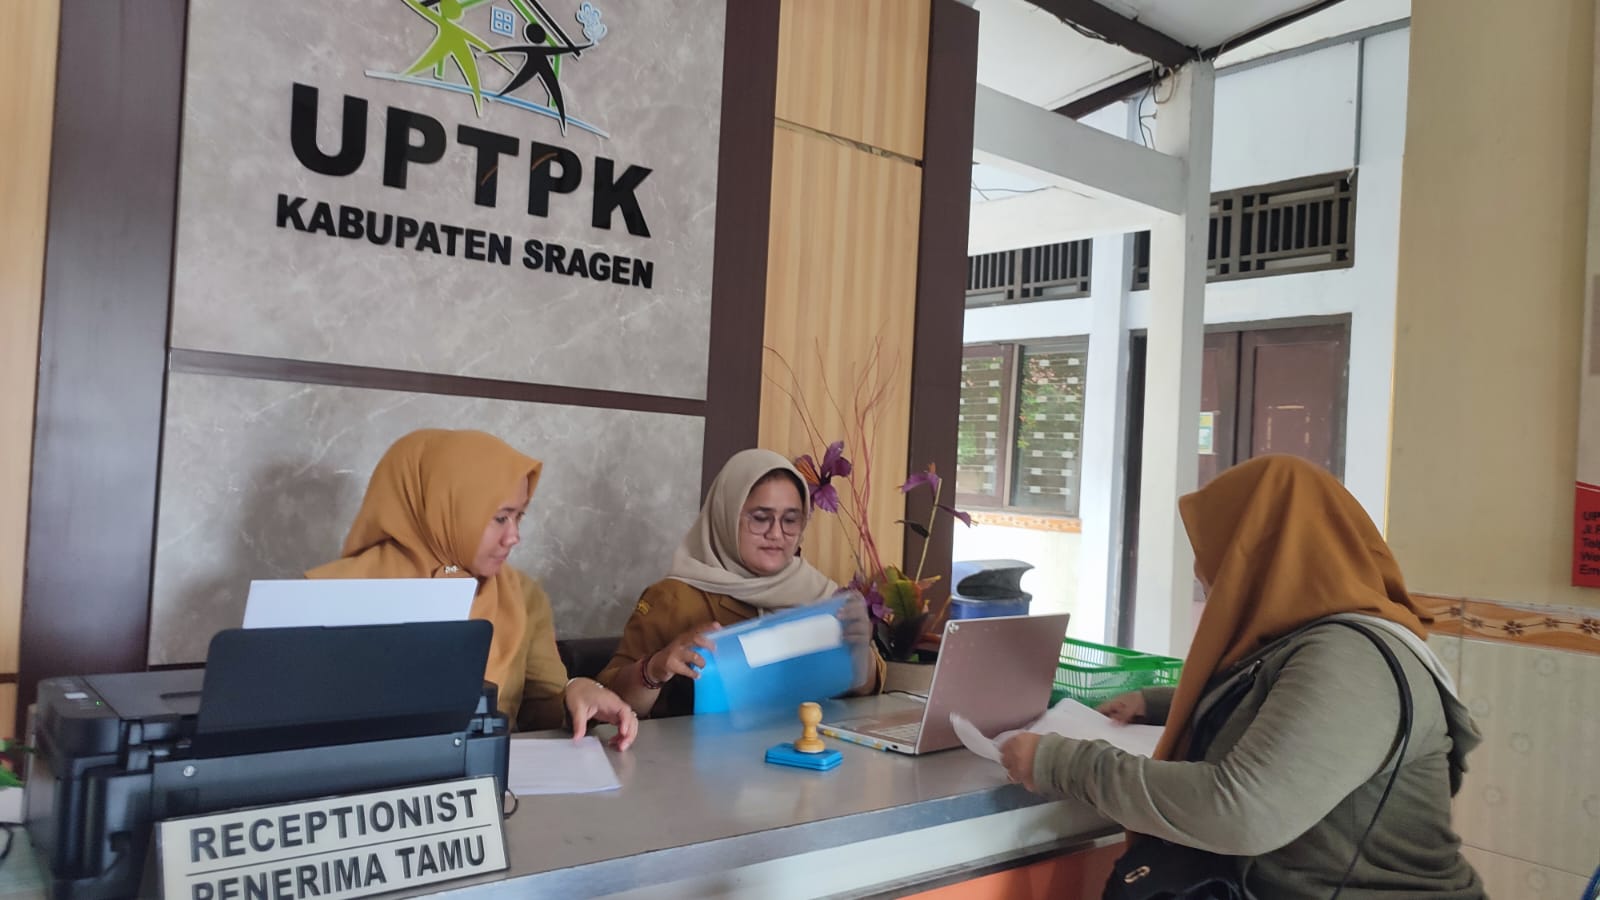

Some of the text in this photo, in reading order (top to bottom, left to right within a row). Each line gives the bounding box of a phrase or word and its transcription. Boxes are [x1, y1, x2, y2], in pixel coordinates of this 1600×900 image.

[290, 82, 653, 239] UPTPK
[276, 193, 654, 290] KABUPATEN SRAGEN
[190, 788, 478, 863] RECEPTIONIST
[191, 834, 485, 900] PENERIMA TAMU
